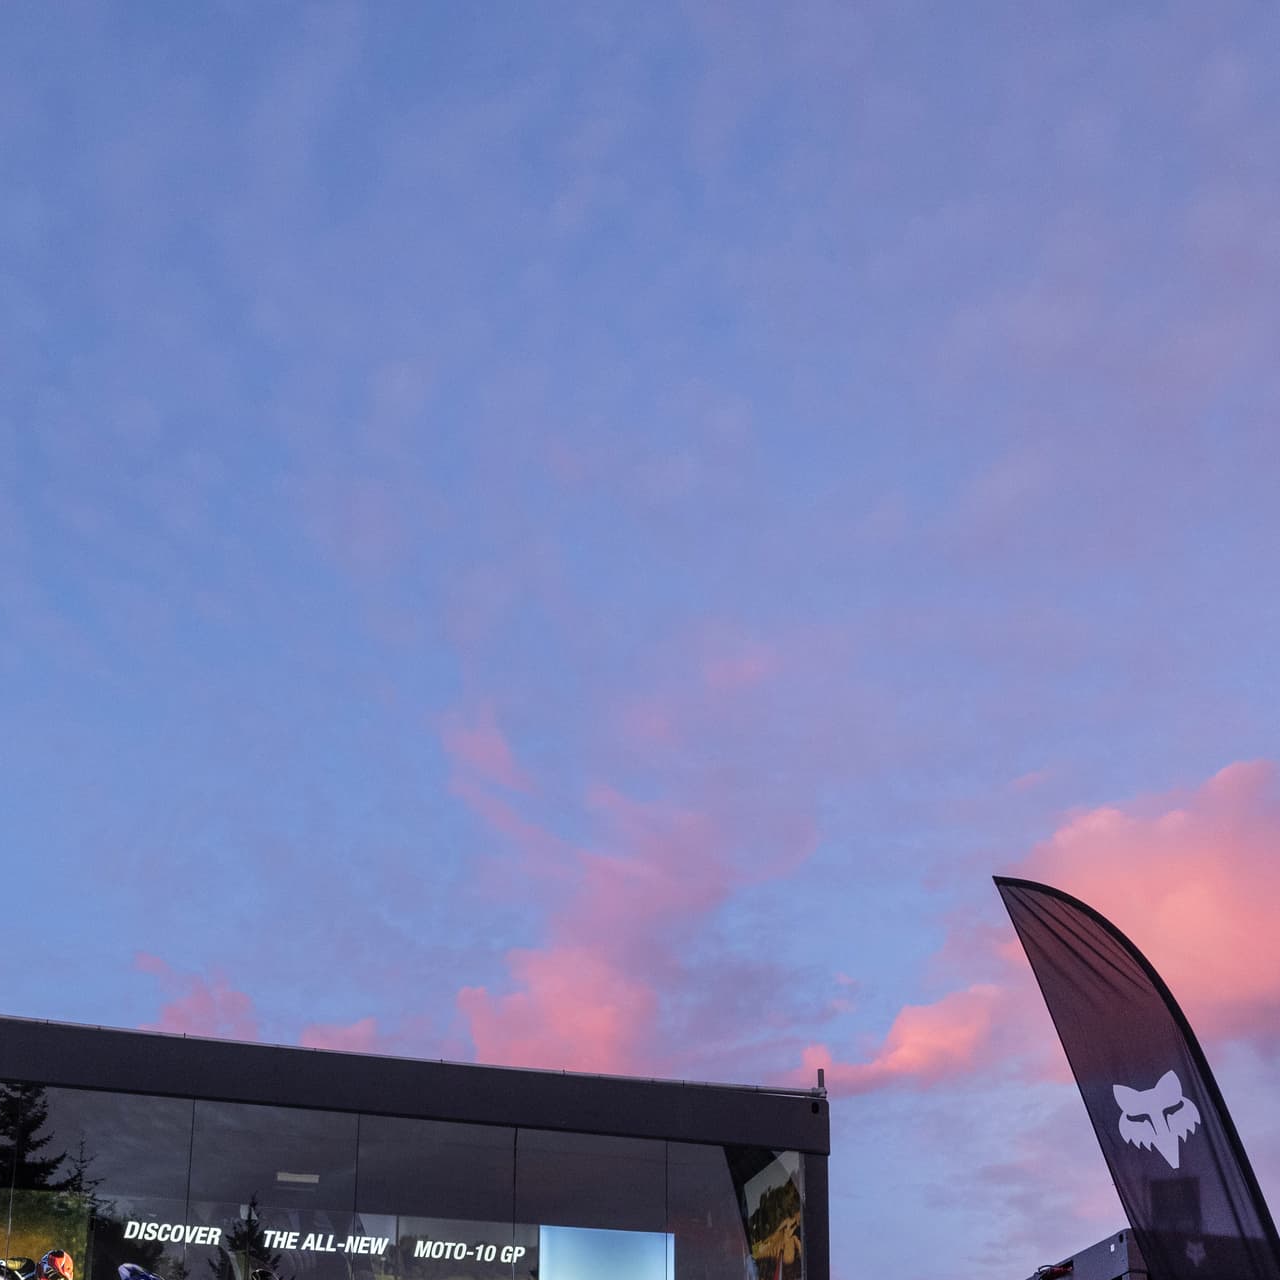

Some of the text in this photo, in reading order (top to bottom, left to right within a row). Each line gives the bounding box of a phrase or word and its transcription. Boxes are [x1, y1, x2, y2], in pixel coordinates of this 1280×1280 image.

[124, 1222, 526, 1263] DISCOVER THE ALL-NEW MOTO-10 GP
